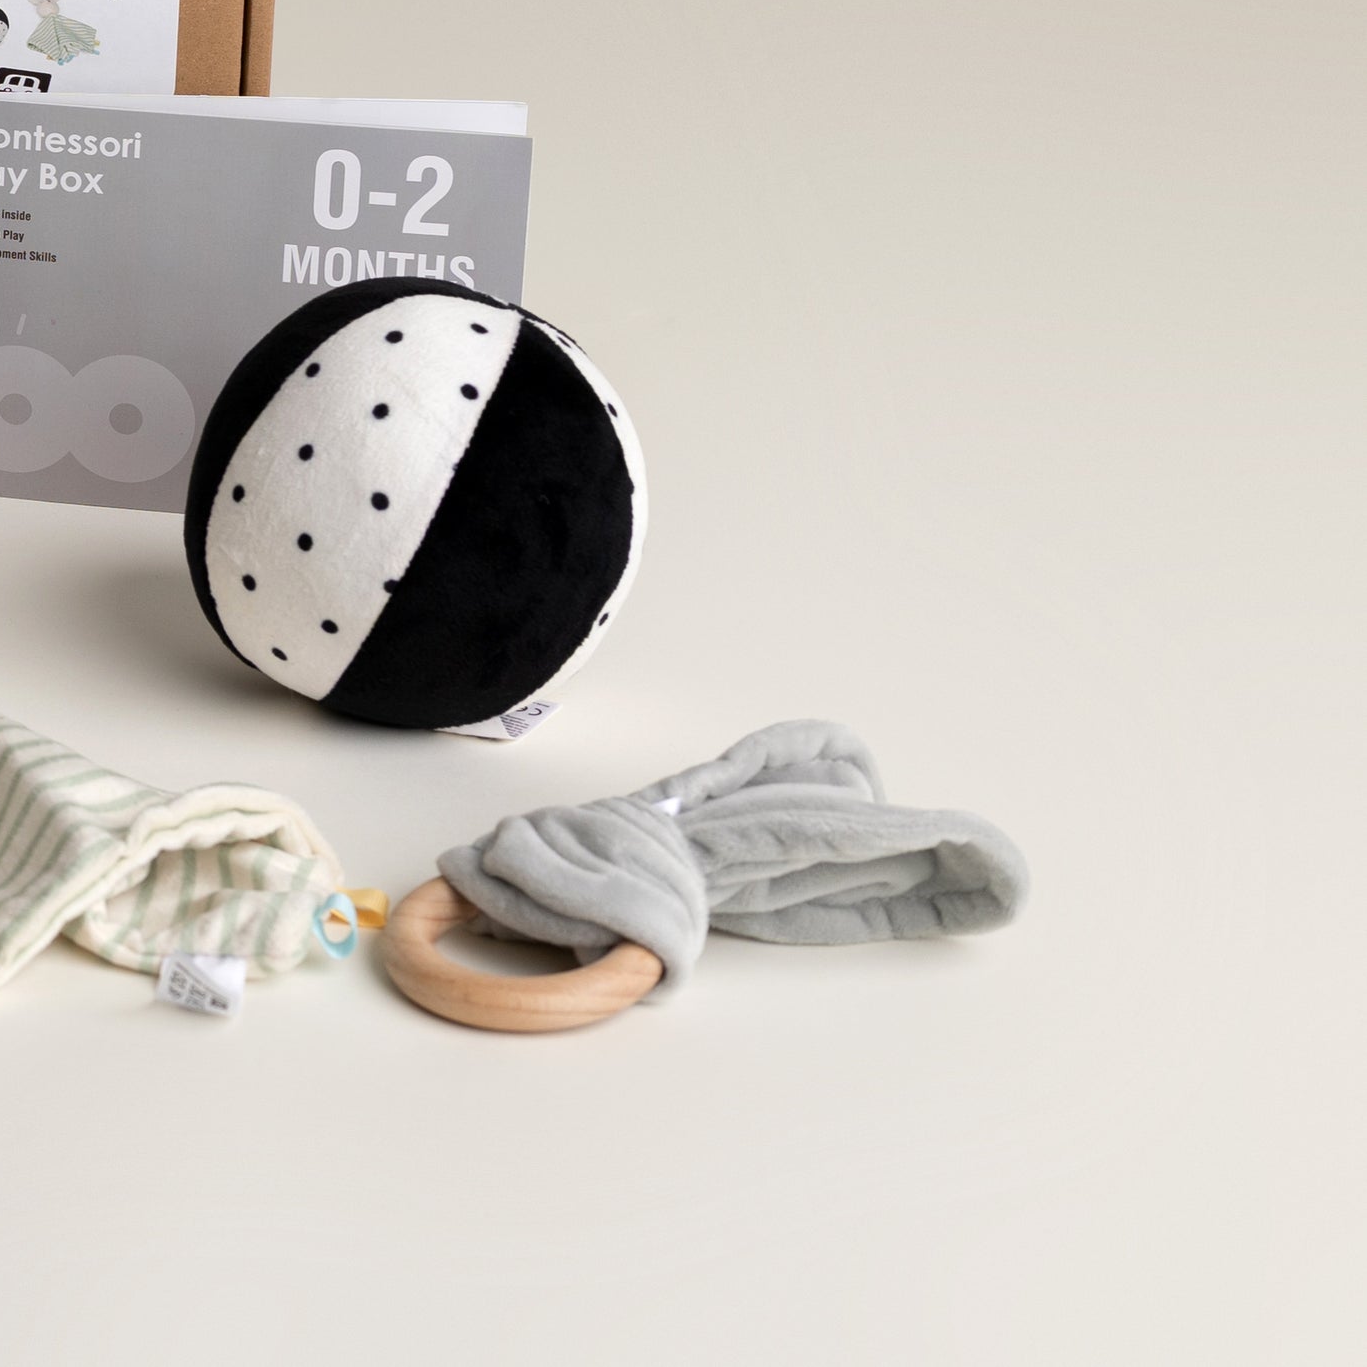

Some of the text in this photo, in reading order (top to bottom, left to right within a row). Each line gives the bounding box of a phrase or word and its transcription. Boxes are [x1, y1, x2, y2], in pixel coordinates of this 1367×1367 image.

[39, 162, 104, 194] Box
[313, 149, 454, 236] 0-2
[3, 230, 25, 243] Play
[29, 251, 57, 263] Skills
[282, 243, 475, 290] MONTHS
